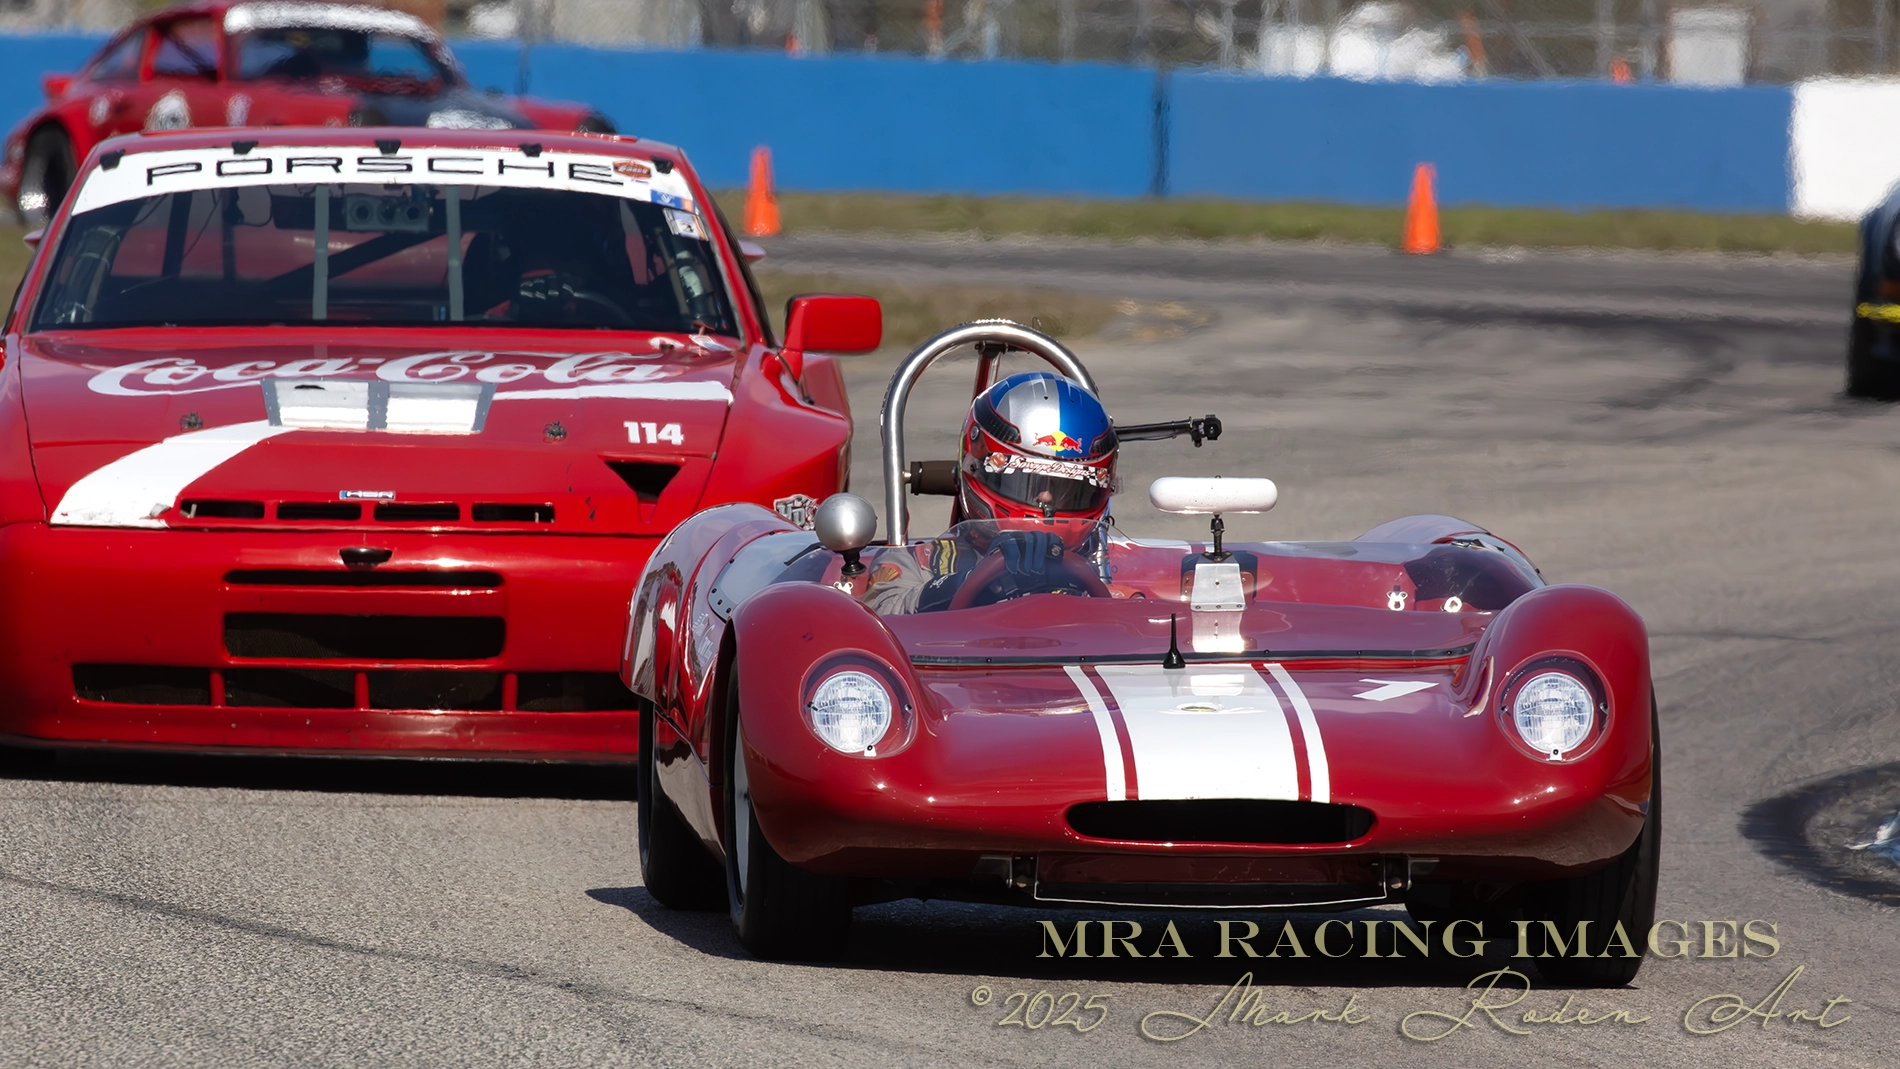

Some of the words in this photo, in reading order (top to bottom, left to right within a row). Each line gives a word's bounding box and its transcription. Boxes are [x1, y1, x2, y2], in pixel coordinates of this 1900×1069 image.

[146, 156, 625, 186] PORSCHE
[88, 351, 671, 395] Coca-Cola
[623, 421, 684, 445] 114
